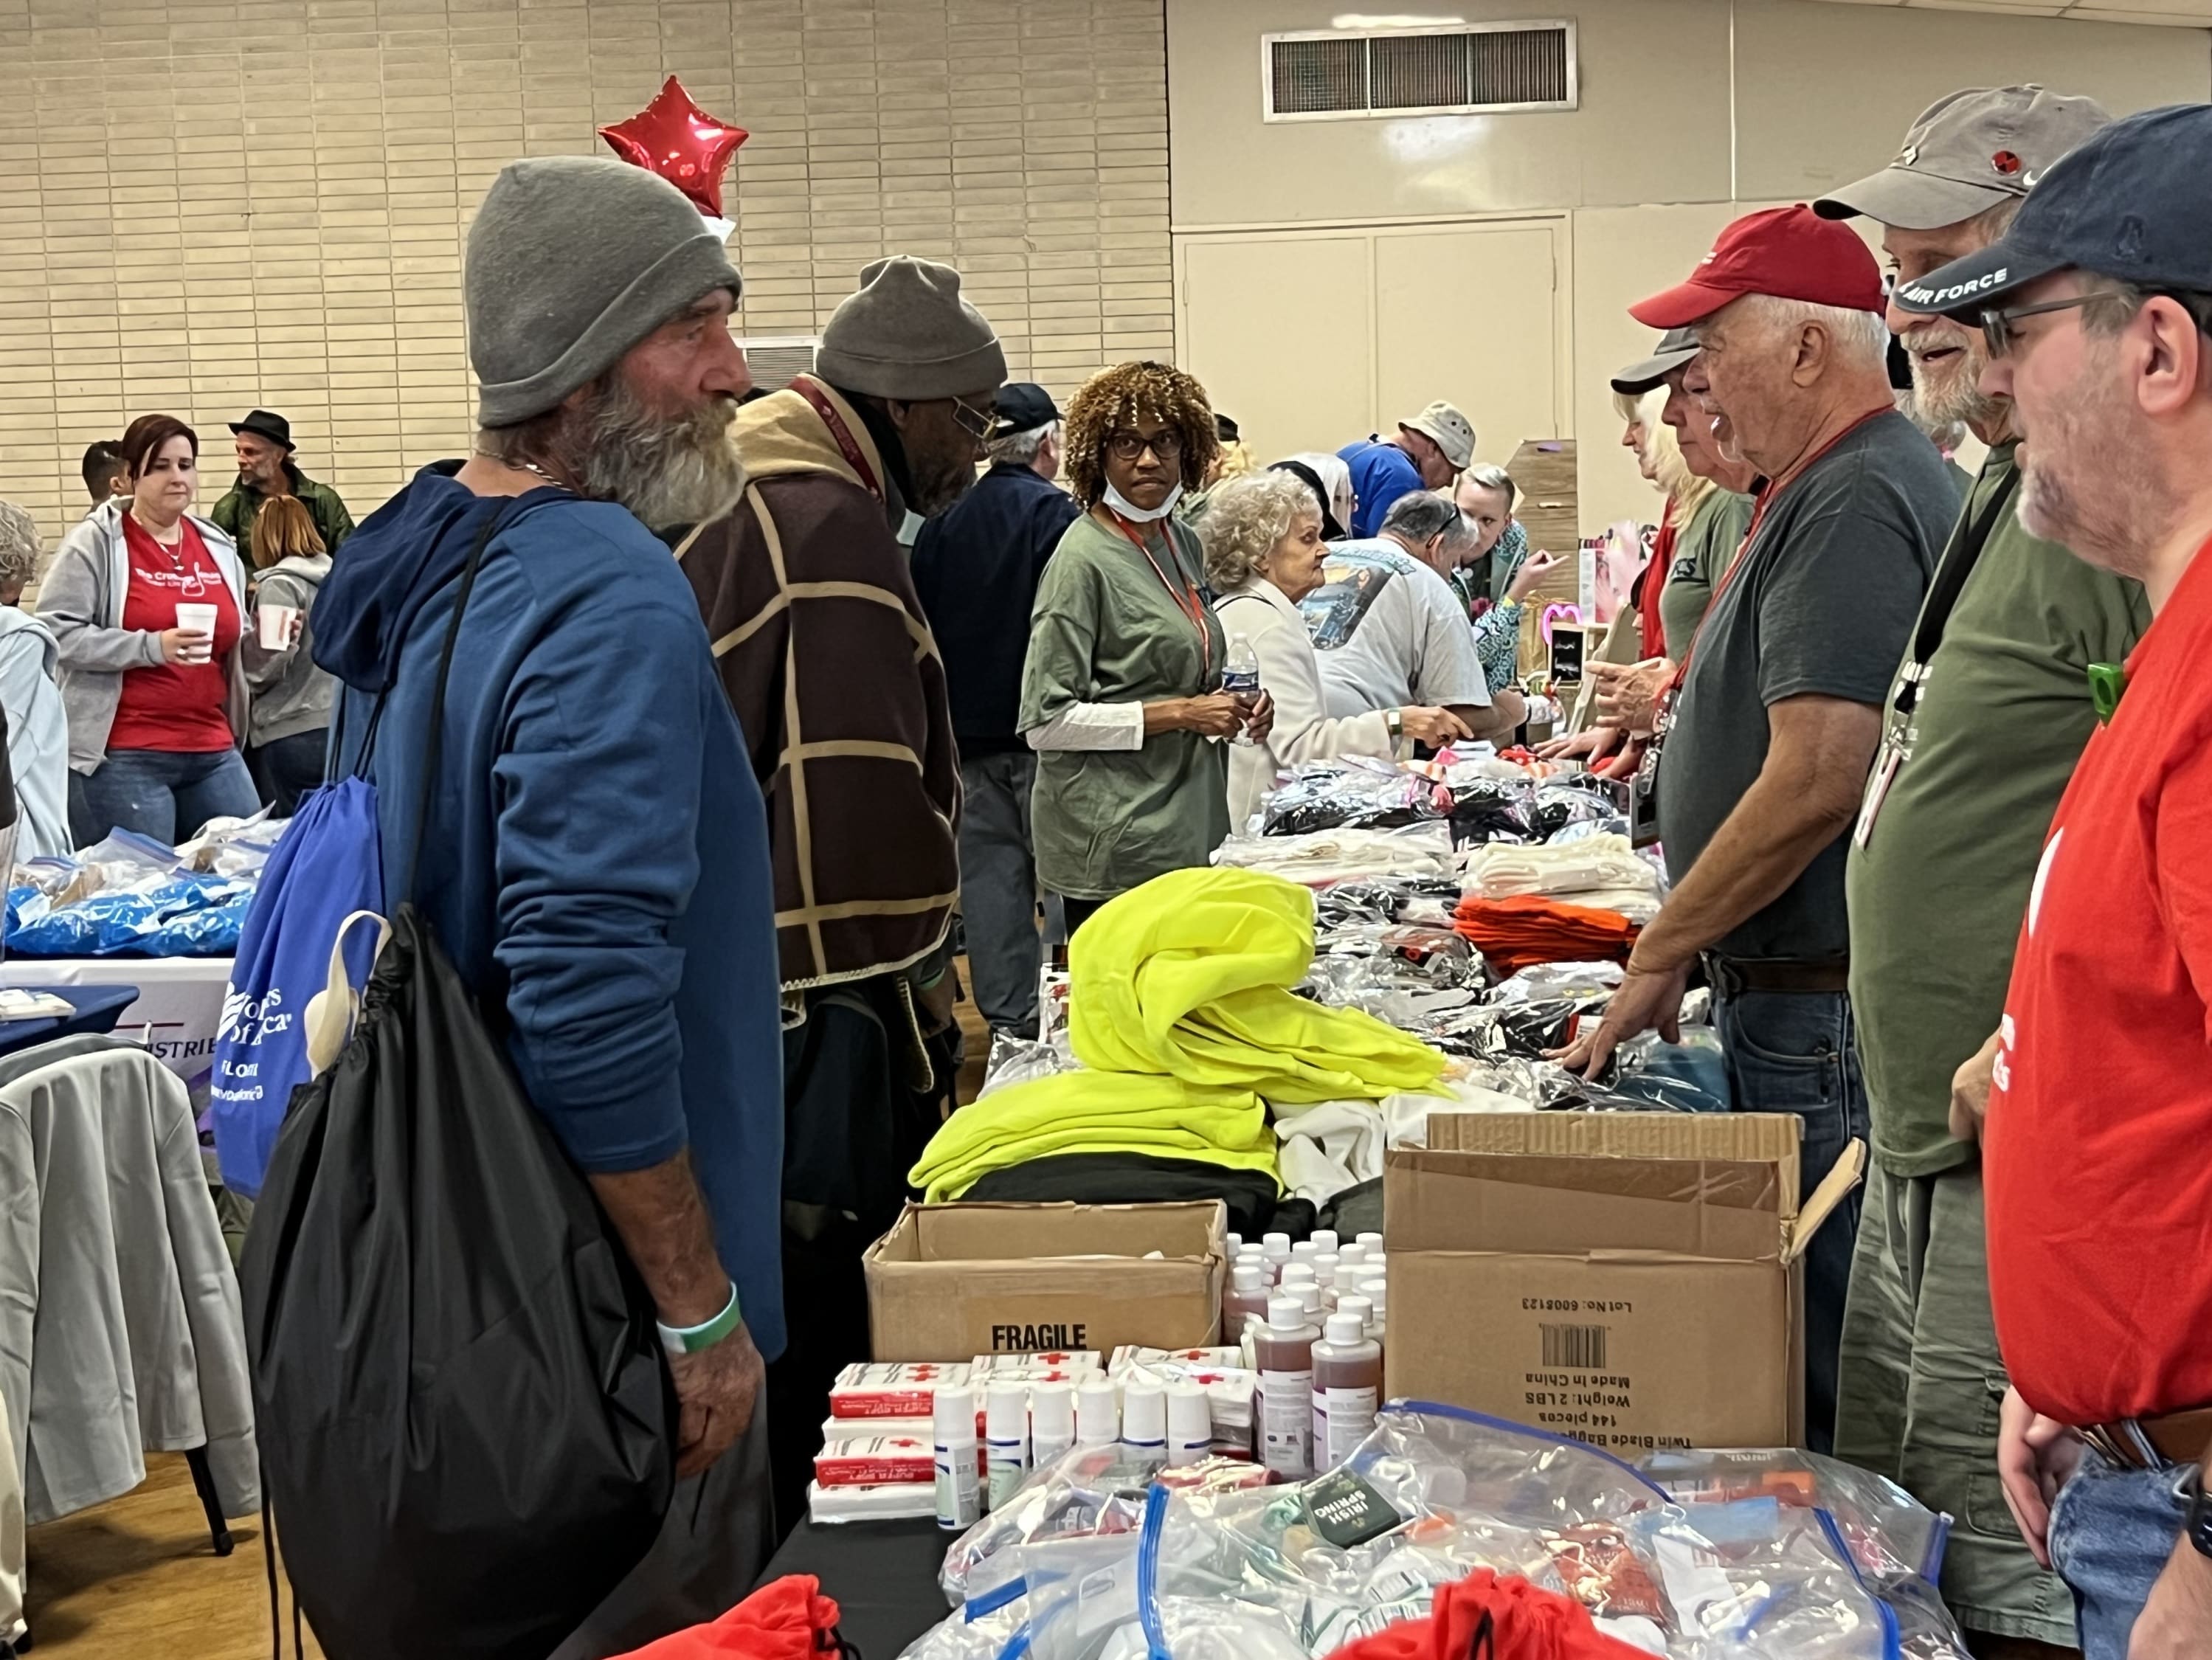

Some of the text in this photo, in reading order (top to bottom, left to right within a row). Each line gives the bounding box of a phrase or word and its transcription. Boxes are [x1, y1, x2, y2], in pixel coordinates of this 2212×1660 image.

[1903, 286, 1935, 305] AIR
[1933, 267, 2008, 303] FORCE
[1583, 1301, 1606, 1312] No:
[1609, 1301, 1632, 1313] Lot
[992, 1324, 1087, 1350] FRAGILE
[1526, 1374, 1569, 1387] China
[1591, 1376, 1630, 1388] Made
[1526, 1391, 1630, 1408] Weight: 2 LBS
[1539, 1411, 1617, 1427] 144 pieces
[1611, 1434, 1654, 1448] Blade
[1659, 1436, 1693, 1450] Twin
[1313, 1490, 1366, 1518] SPRING
[1328, 1503, 1369, 1525] IRISH
